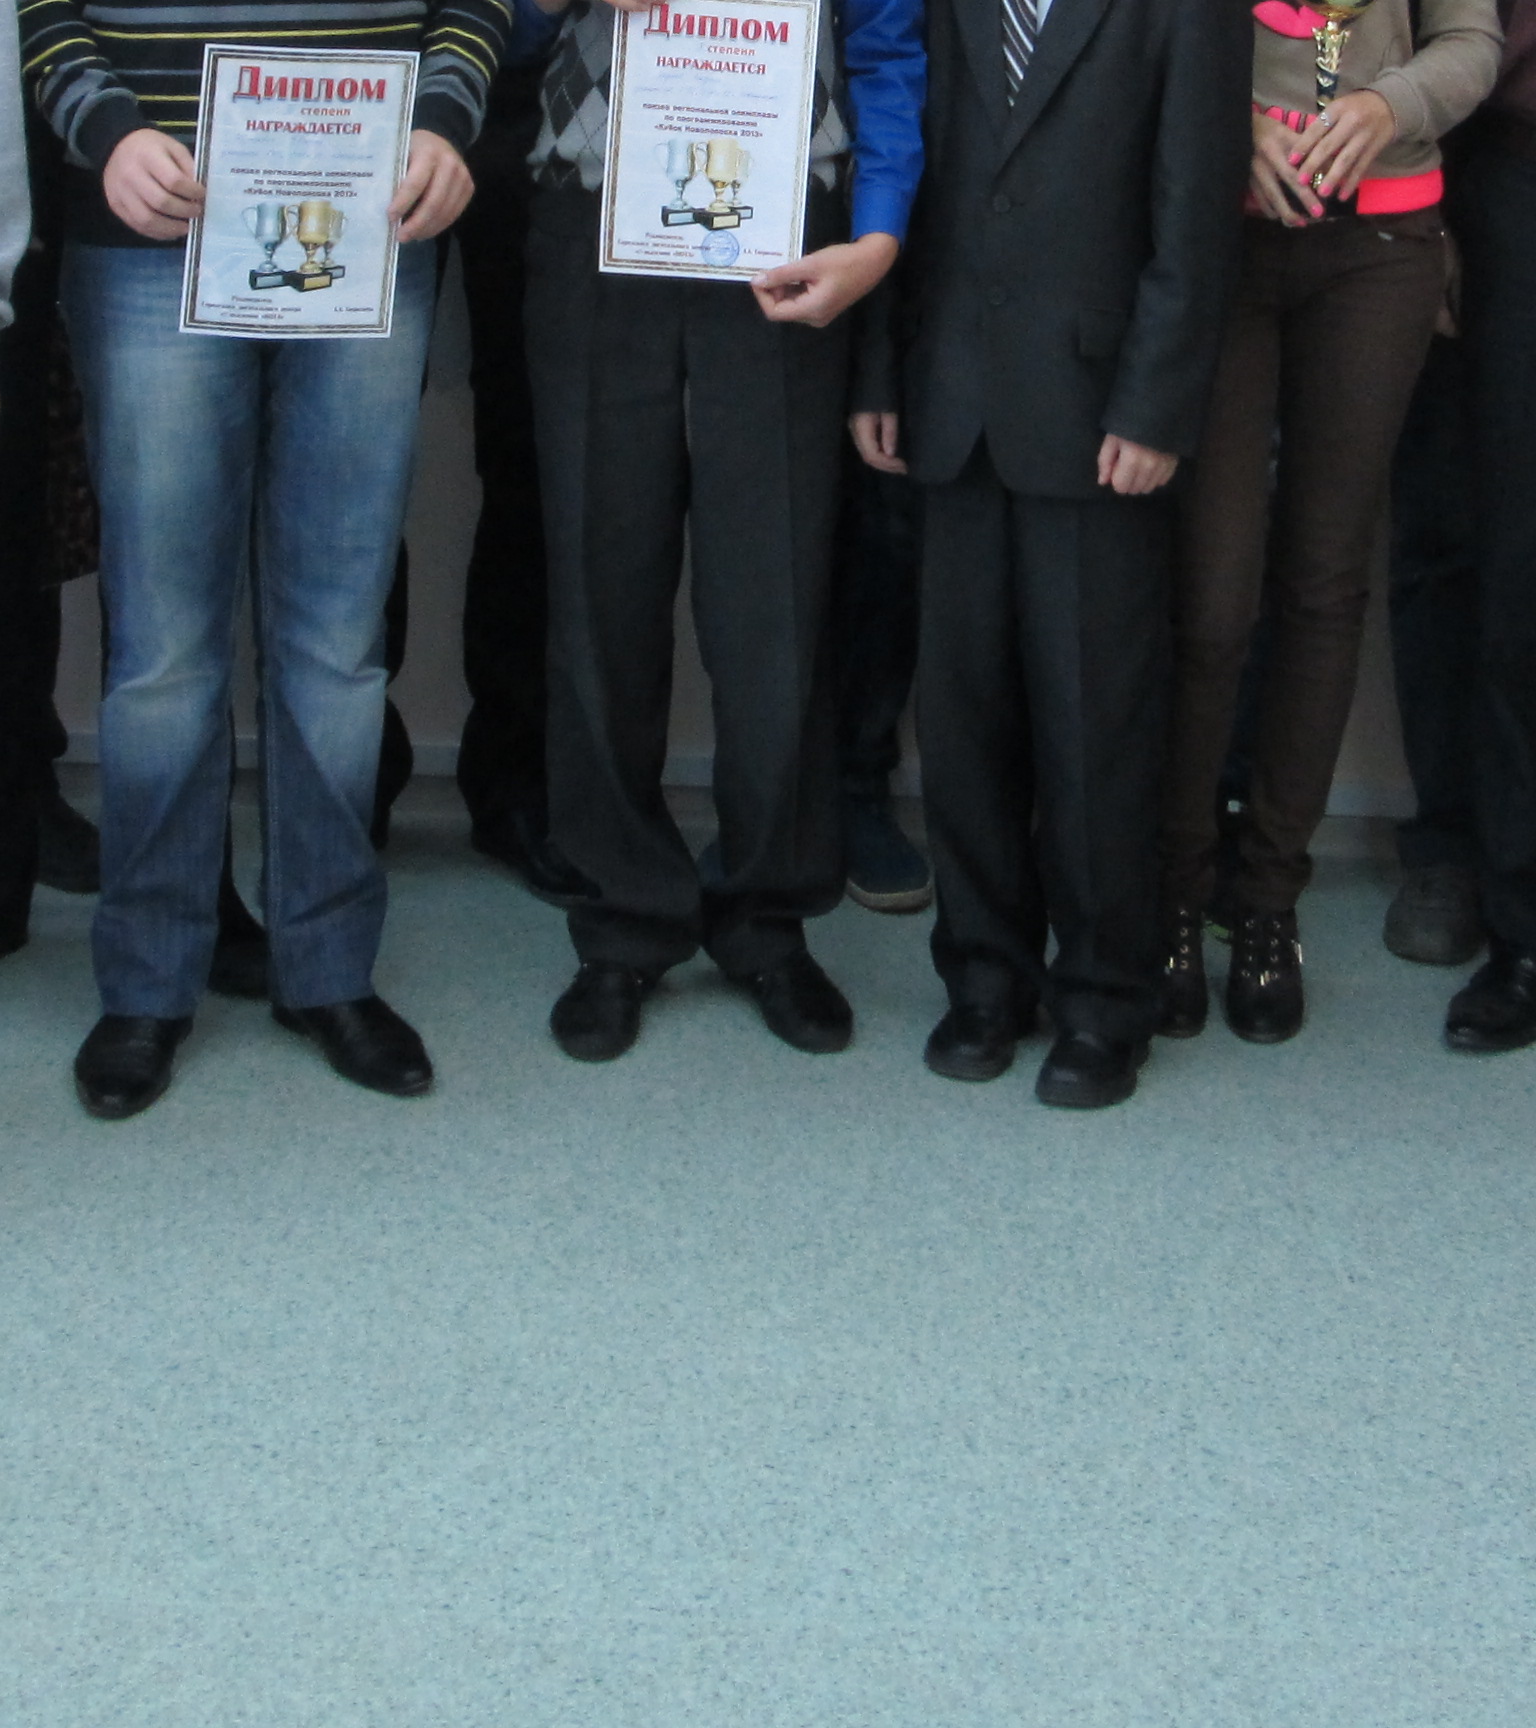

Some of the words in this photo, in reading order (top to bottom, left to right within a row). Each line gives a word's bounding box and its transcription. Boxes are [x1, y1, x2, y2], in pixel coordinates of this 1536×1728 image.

[642, 2, 790, 44] Диплом
[707, 45, 756, 57] степени
[656, 55, 767, 76] НАГРАЖДАЕТСЯ
[232, 64, 387, 105] Диплом
[246, 118, 362, 135] НАГРАЖДАЕТСЯ
